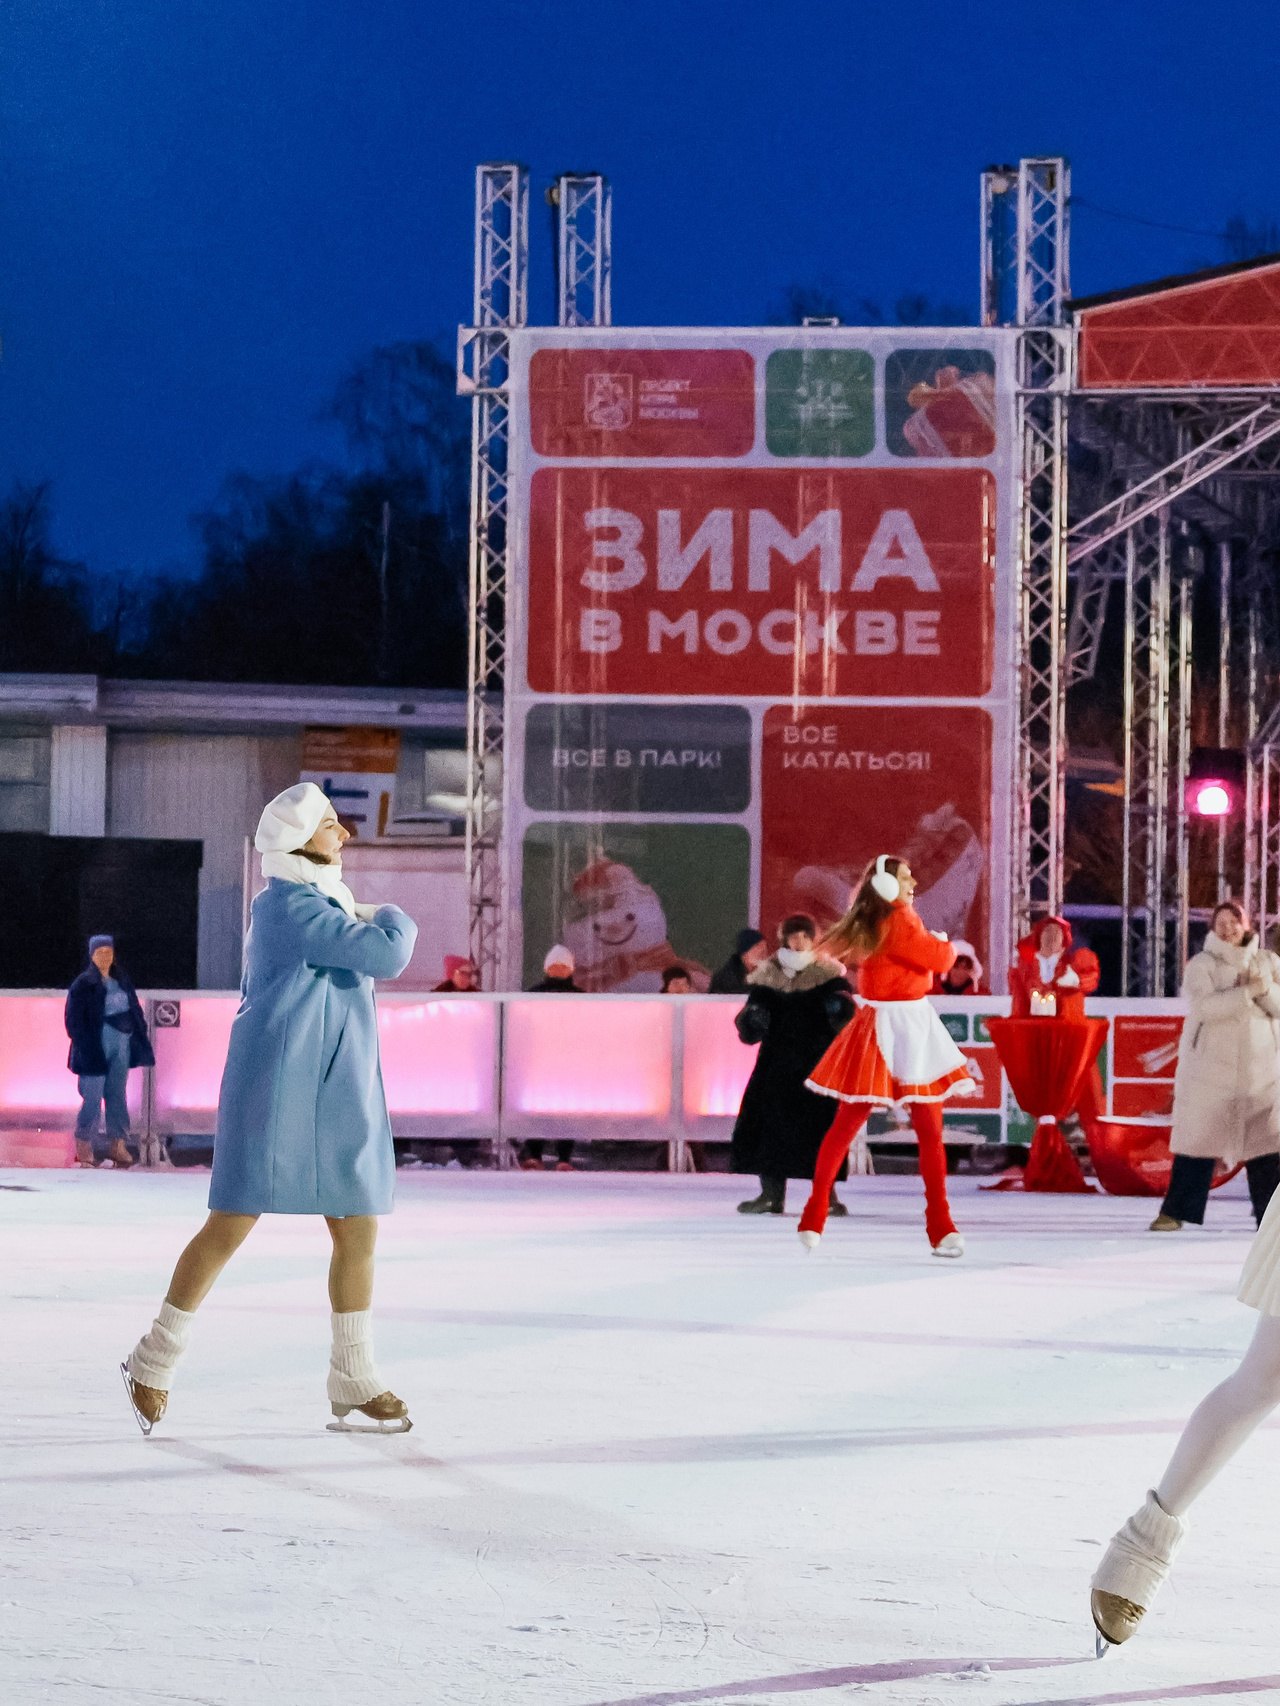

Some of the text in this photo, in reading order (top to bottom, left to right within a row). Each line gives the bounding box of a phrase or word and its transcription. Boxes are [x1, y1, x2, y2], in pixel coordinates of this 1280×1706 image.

[580, 507, 941, 592] ЗИМА
[580, 609, 941, 655] В МОСКВЕ
[783, 725, 837, 744] ВСЕ
[553, 749, 606, 767] ВСЕ
[615, 749, 632, 767] В
